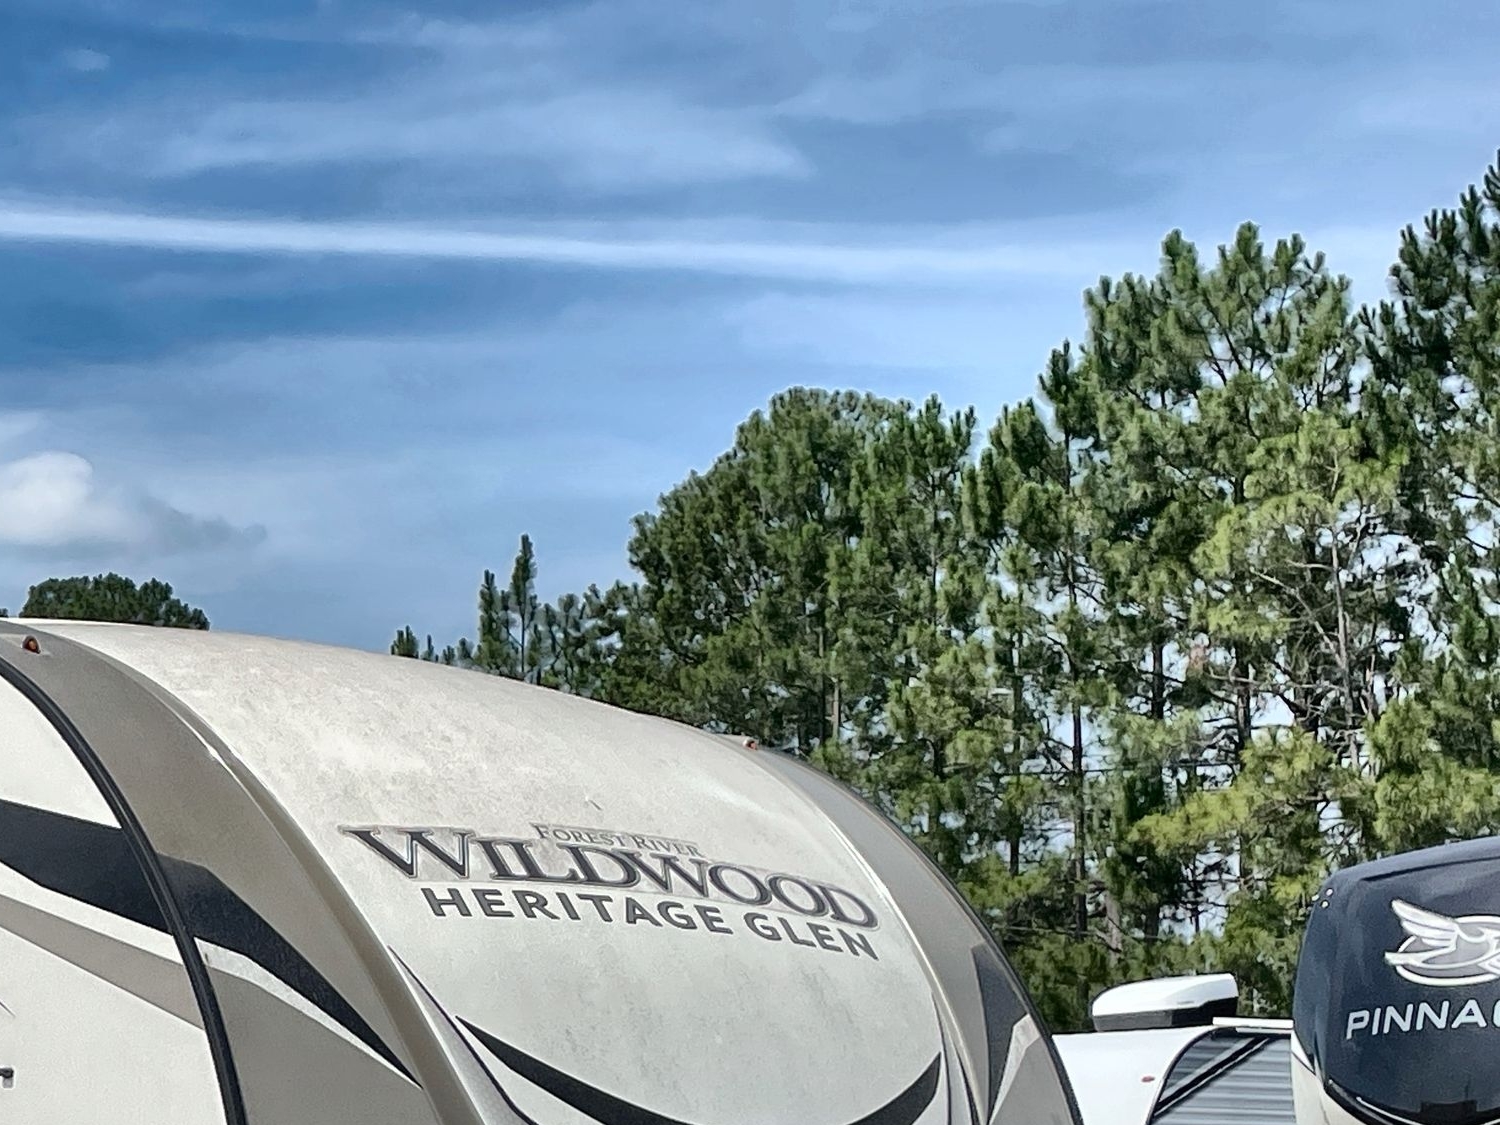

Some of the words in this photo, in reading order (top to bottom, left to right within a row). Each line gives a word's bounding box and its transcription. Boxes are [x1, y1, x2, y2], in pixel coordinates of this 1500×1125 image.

[338, 824, 881, 931] WILDWOOD
[420, 887, 734, 935] HERITAGE
[743, 911, 880, 962] GLEN
[1345, 998, 1500, 1041] PINNA
